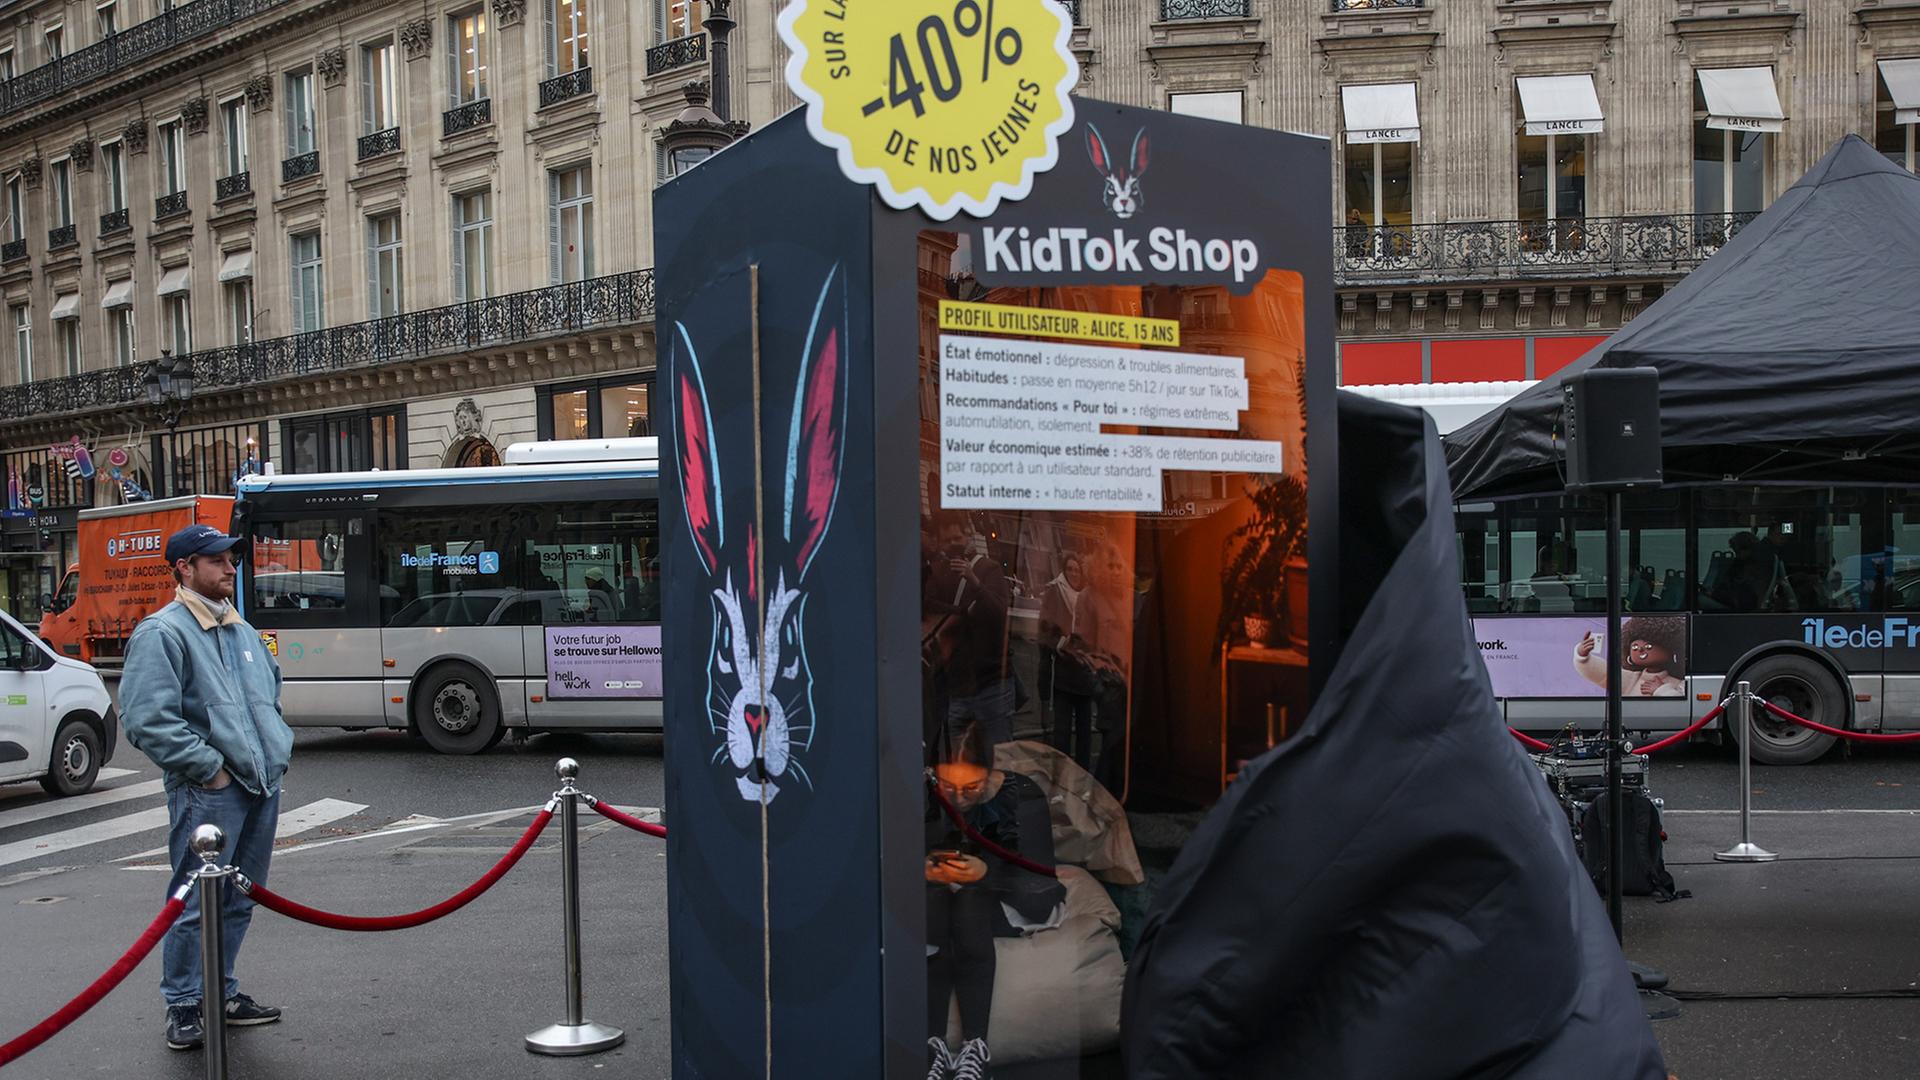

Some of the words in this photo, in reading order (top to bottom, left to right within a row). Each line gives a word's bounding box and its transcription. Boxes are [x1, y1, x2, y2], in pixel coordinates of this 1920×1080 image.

[823, 30, 850, 80] SUR
[861, 0, 1023, 118] -40%
[885, 129, 919, 166] DE
[929, 145, 977, 174] NOS
[981, 78, 1041, 164] JEUNES
[1546, 121, 1584, 130] LANCEL
[1727, 117, 1762, 128] LANCEL
[1366, 130, 1401, 139] LANCEL
[982, 226, 1143, 273] KidTok
[1149, 226, 1259, 283] Shop
[945, 307, 994, 328] PROFIL
[998, 312, 1079, 335] UTILISATEUR
[1091, 321, 1130, 339] ALICE,
[1134, 323, 1147, 340] 15
[1151, 325, 1174, 342] ANS
[946, 343, 971, 360] État
[975, 347, 1042, 364] émotionnel
[1054, 353, 1115, 369] dépression
[1118, 358, 1127, 370] &
[1129, 359, 1172, 374] troubles
[1175, 361, 1239, 378] alimentaires.
[946, 368, 1009, 385] Habitudes
[1021, 376, 1054, 388] passe
[1057, 378, 1072, 388] en
[1075, 379, 1126, 393] moyenne
[1128, 379, 1157, 394] 5h12
[1166, 381, 1186, 397] jour
[1189, 386, 1206, 396] sur
[946, 393, 1058, 411] Recommandations
[1073, 400, 1100, 414] Pour
[1103, 401, 1118, 415] toi
[1140, 407, 1181, 420] régimes
[1183, 408, 1233, 422] extrêmes,
[945, 414, 1034, 431] automutilation,
[1038, 417, 1096, 432] isolement.
[946, 438, 985, 453] Valeur
[989, 440, 1061, 458] économique
[1065, 444, 1110, 457] estimée
[1121, 445, 1153, 459] +38%
[1157, 447, 1170, 459] de
[1173, 447, 1218, 461] rétention
[1221, 449, 1275, 464] publicitaire
[946, 461, 966, 474] par
[970, 462, 1014, 476] rapport
[1017, 461, 1024, 474] à
[1028, 463, 1044, 475] un
[1047, 462, 1101, 476] utilisateur
[1104, 465, 1155, 478] standard.
[946, 483, 985, 498] Statut
[989, 484, 1032, 499] interne
[1054, 486, 1086, 500] haute
[1089, 487, 1143, 501] rentabilité
[29, 516, 58, 527] SEHORA
[118, 535, 161, 553] H-TUBE
[400, 553, 477, 567] îledeFrance
[443, 566, 477, 575] mobilités
[553, 634, 580, 645] Votre
[581, 633, 605, 645] futur
[605, 633, 622, 646] job
[553, 648, 566, 657] se
[567, 647, 600, 656] trouve
[601, 647, 617, 656] sur
